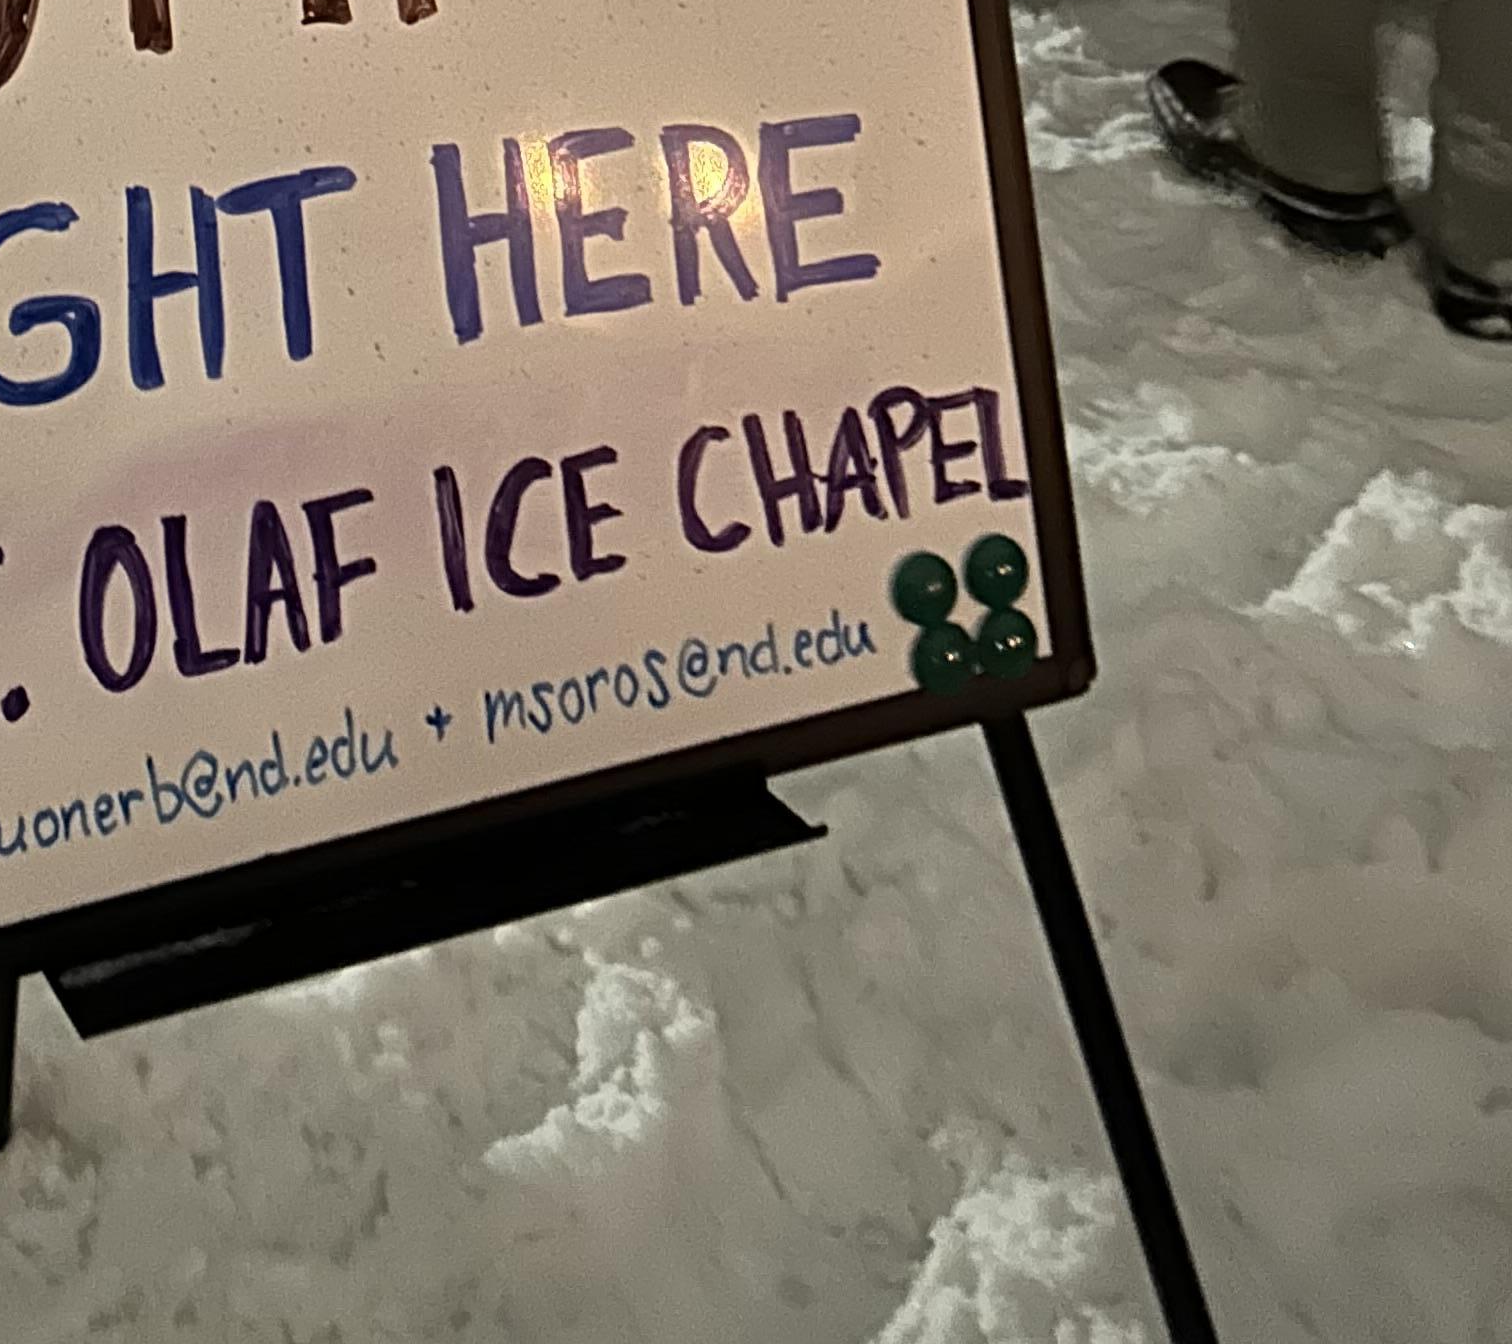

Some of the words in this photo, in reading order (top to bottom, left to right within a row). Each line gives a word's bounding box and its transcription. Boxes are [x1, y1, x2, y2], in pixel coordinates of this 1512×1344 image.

[430, 114, 881, 345] HERE
[79, 488, 377, 693] OLAF
[433, 445, 627, 613] ICE
[678, 386, 1028, 553] CHAPEL
[485, 609, 876, 744] msoros@nd.edu
